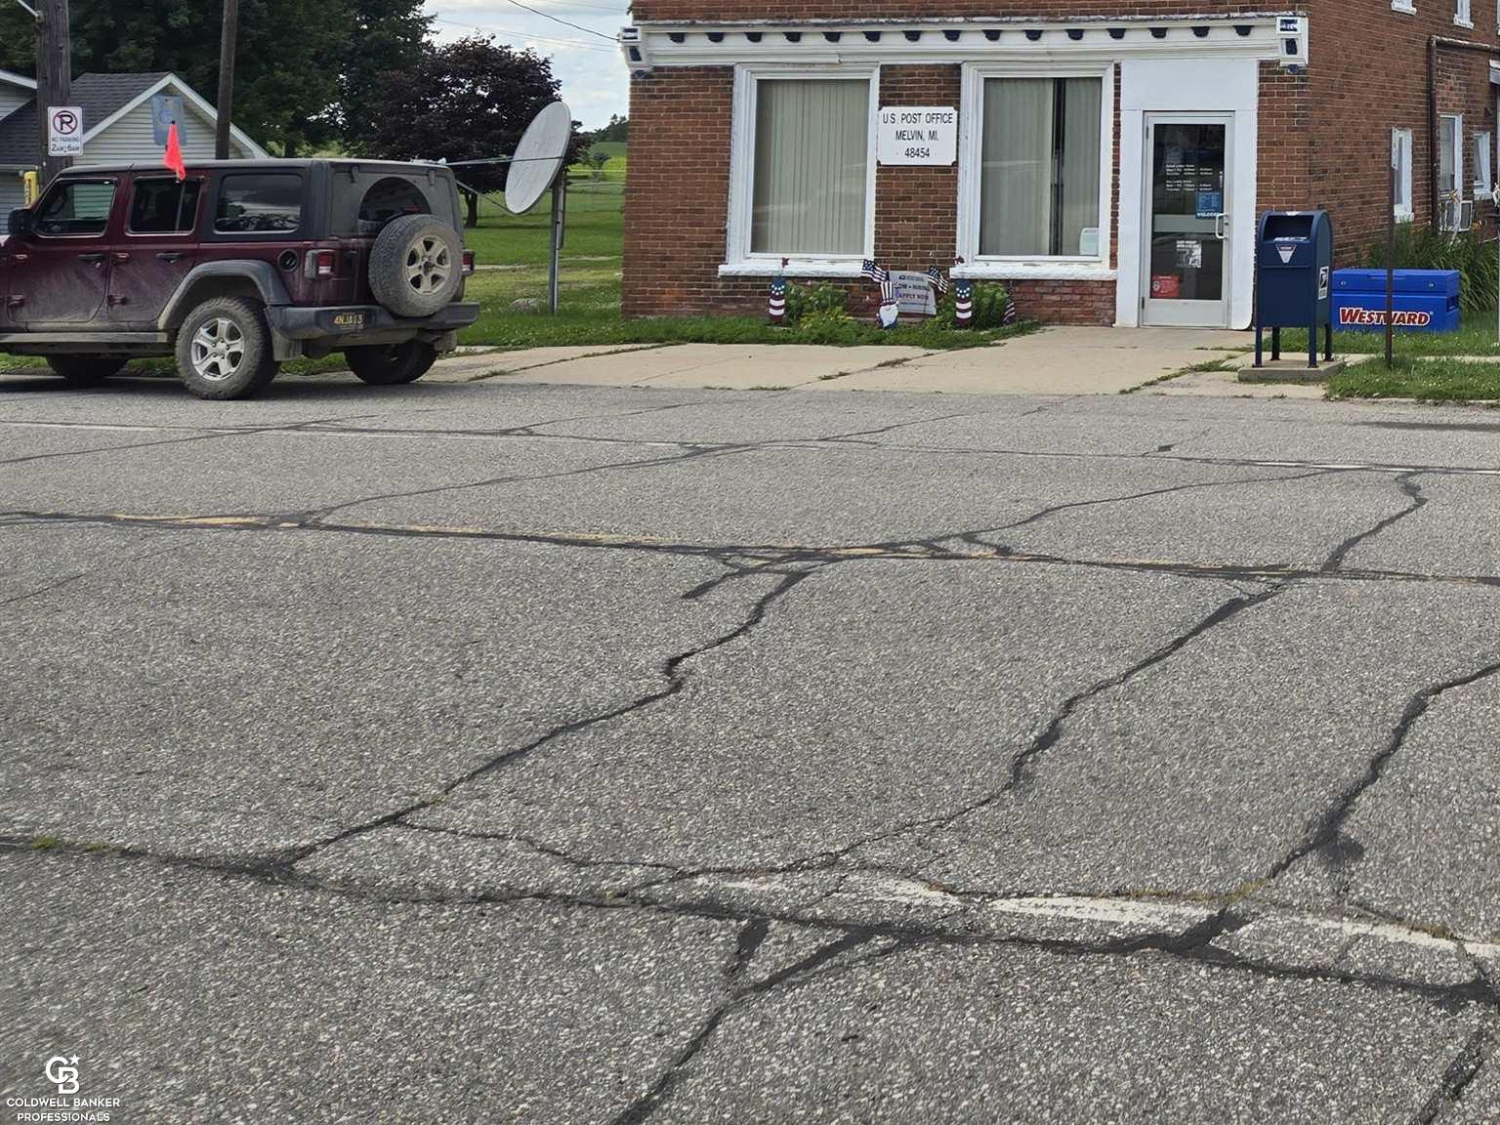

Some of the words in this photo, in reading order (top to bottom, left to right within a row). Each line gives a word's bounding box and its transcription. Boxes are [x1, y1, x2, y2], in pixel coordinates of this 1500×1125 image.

[900, 112, 922, 124] POST
[925, 112, 953, 124] OFFICE
[904, 147, 930, 158] 48454
[1339, 307, 1431, 326] WESTWARD
